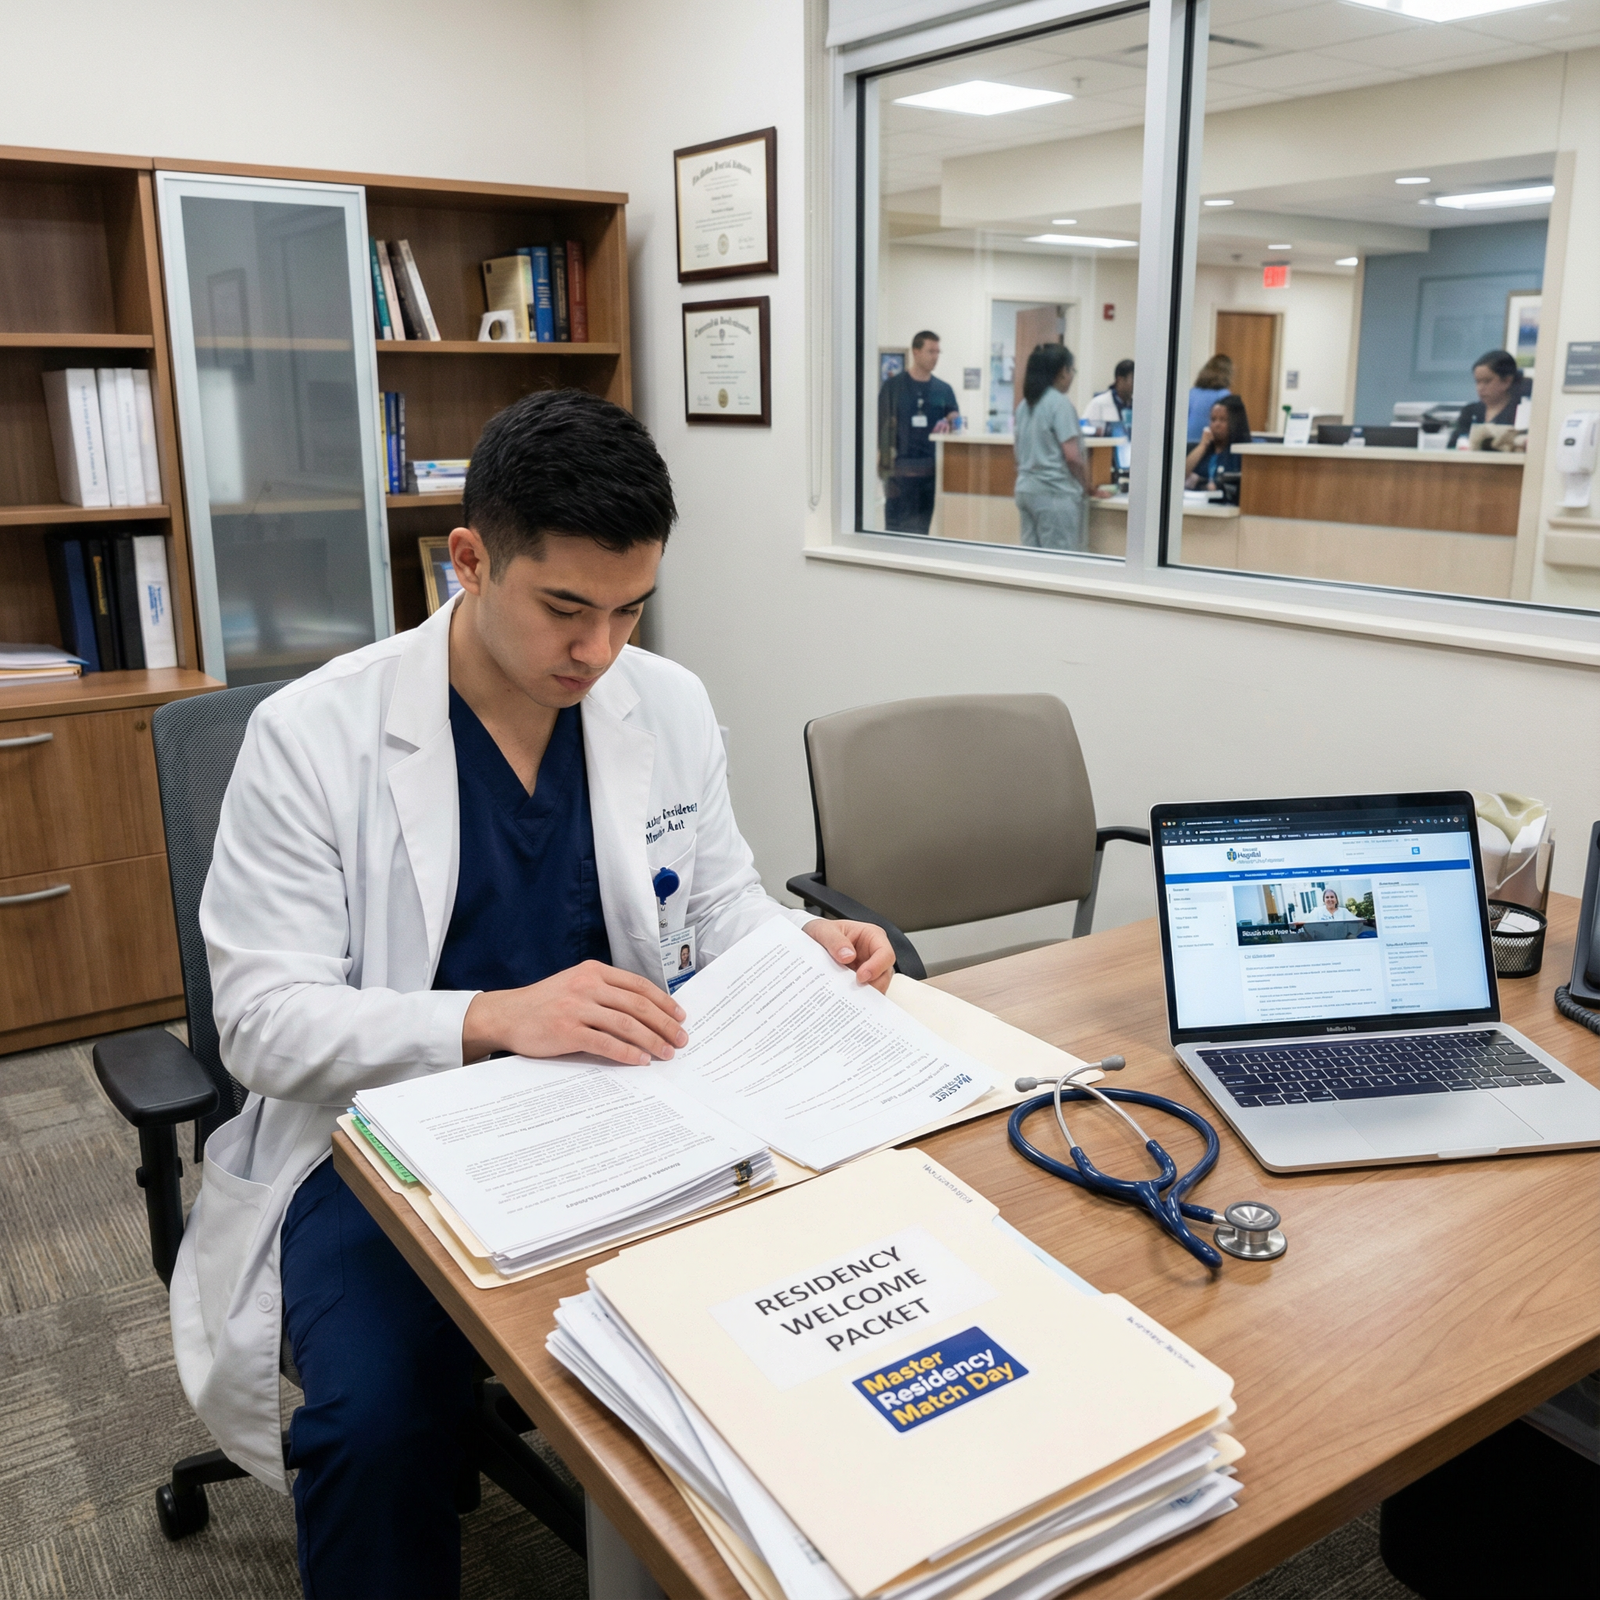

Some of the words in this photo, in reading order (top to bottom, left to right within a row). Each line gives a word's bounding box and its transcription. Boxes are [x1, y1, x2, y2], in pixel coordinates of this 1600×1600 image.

[754, 1245, 901, 1316] RESIDENCY
[780, 1268, 927, 1336] WELCOME
[825, 1297, 930, 1352] PACKET
[861, 1351, 943, 1395] Master
[876, 1348, 995, 1411] Residency
[892, 1384, 969, 1426] Match
[965, 1361, 1014, 1391] Day
